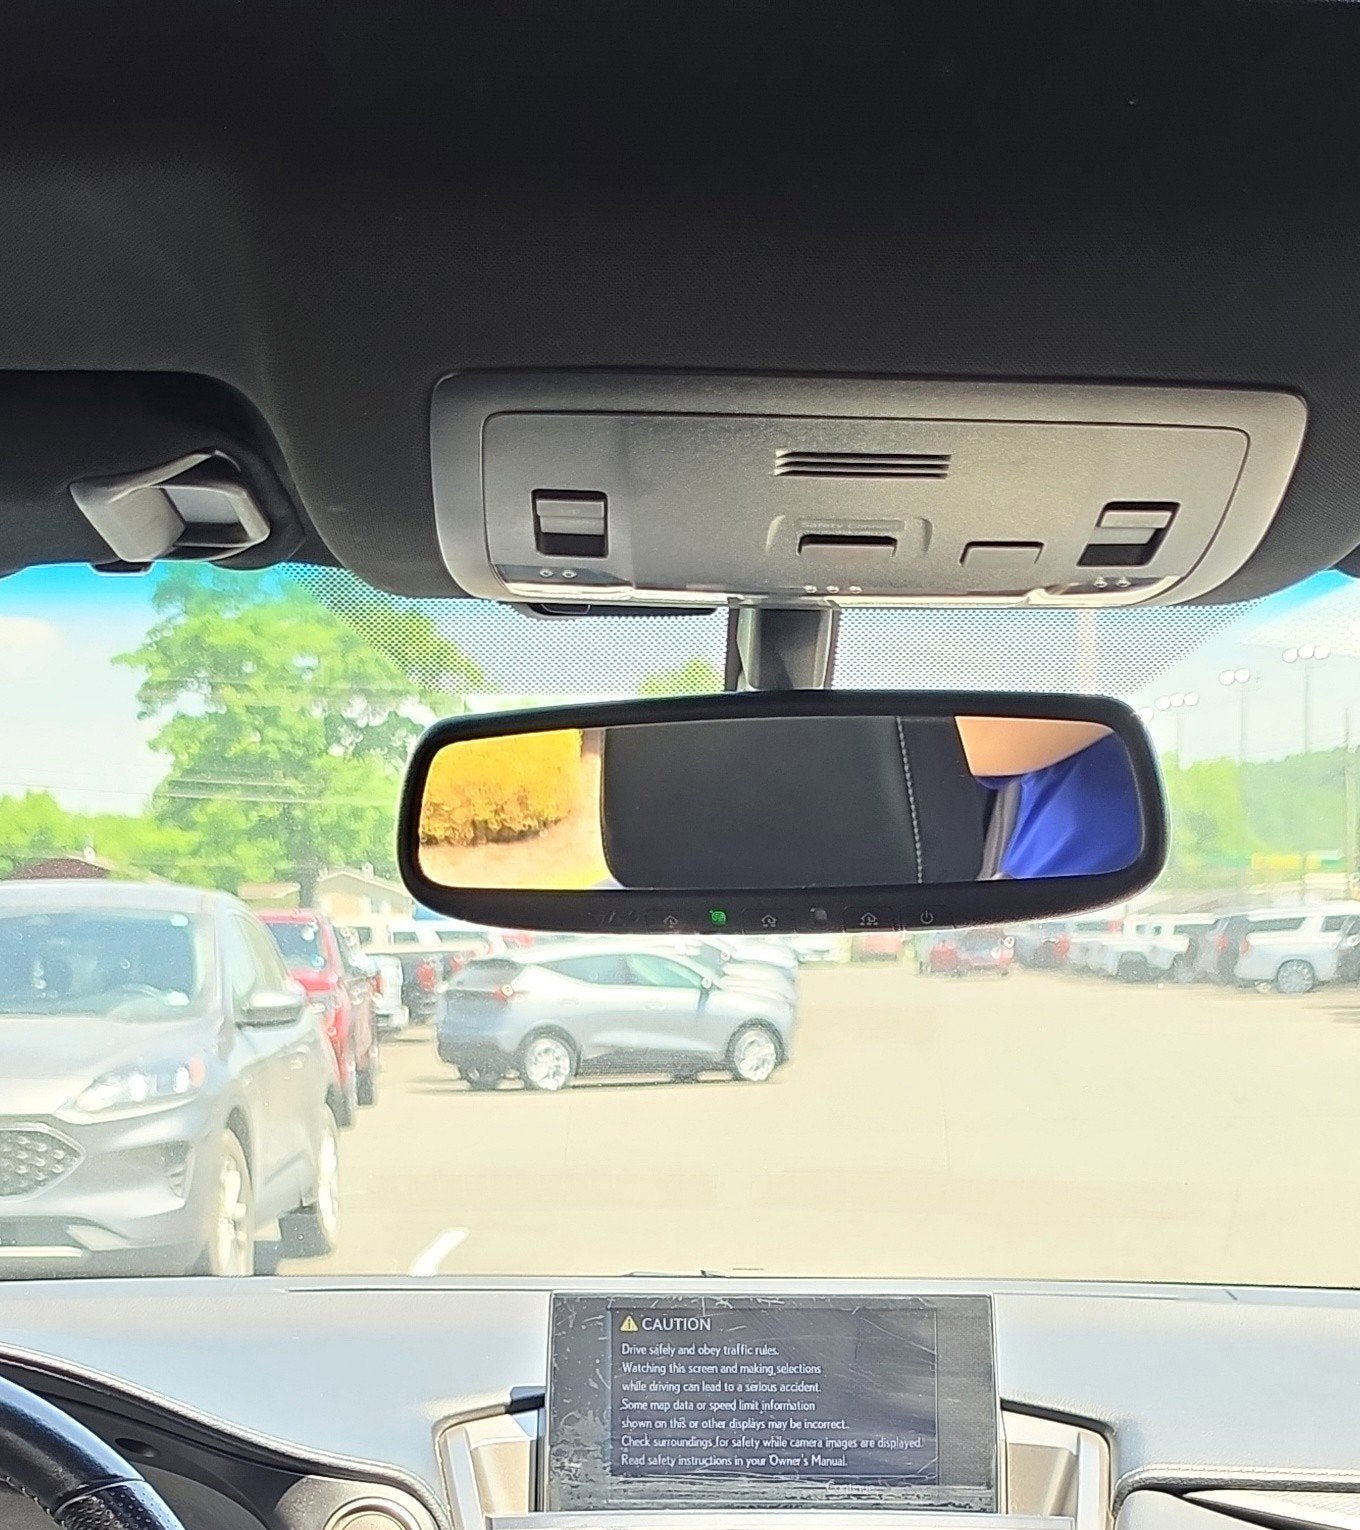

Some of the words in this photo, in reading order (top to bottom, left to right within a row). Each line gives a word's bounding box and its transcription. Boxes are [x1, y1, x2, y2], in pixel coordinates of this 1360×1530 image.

[642, 1317, 711, 1331] CAUTION
[621, 1343, 647, 1354] Drive
[648, 1343, 676, 1357] safely
[678, 1343, 695, 1354] and
[697, 1343, 721, 1357] obey
[723, 1343, 752, 1354] traffic
[622, 1361, 666, 1376] Watching
[669, 1362, 686, 1373] this
[688, 1364, 718, 1374] screen
[720, 1362, 738, 1374] and
[740, 1362, 774, 1376] making
[776, 1363, 822, 1374] selections
[622, 1381, 647, 1392] while
[649, 1381, 680, 1395] driving
[683, 1383, 700, 1392] can
[702, 1381, 721, 1392] lead
[724, 1381, 734, 1392] to
[737, 1384, 743, 1392] a
[780, 1381, 822, 1392] accident.
[621, 1399, 648, 1411] Some
[650, 1401, 671, 1413] map
[673, 1399, 693, 1411] data
[696, 1401, 706, 1411] or
[709, 1399, 736, 1413] speed
[739, 1399, 759, 1411] limit
[761, 1399, 816, 1411] information
[621, 1417, 652, 1429] shown
[655, 1419, 667, 1429] on
[689, 1419, 699, 1429] or
[701, 1418, 726, 1429] other
[729, 1417, 766, 1431] displays
[768, 1420, 788, 1431] may
[790, 1418, 802, 1429] be
[621, 1435, 651, 1448] Check
[653, 1436, 713, 1450] surroundings
[716, 1436, 729, 1448] for
[731, 1436, 760, 1450] safety
[762, 1436, 788, 1448] while
[790, 1439, 823, 1448] camera
[825, 1437, 857, 1450] images
[860, 1439, 875, 1448] are
[621, 1454, 646, 1466] Read
[648, 1455, 676, 1468] safety
[678, 1455, 732, 1466] instructions
[735, 1455, 744, 1466] in
[746, 1458, 767, 1469] your
[770, 1454, 809, 1467] Owner's
[811, 1454, 848, 1467] Manual.
